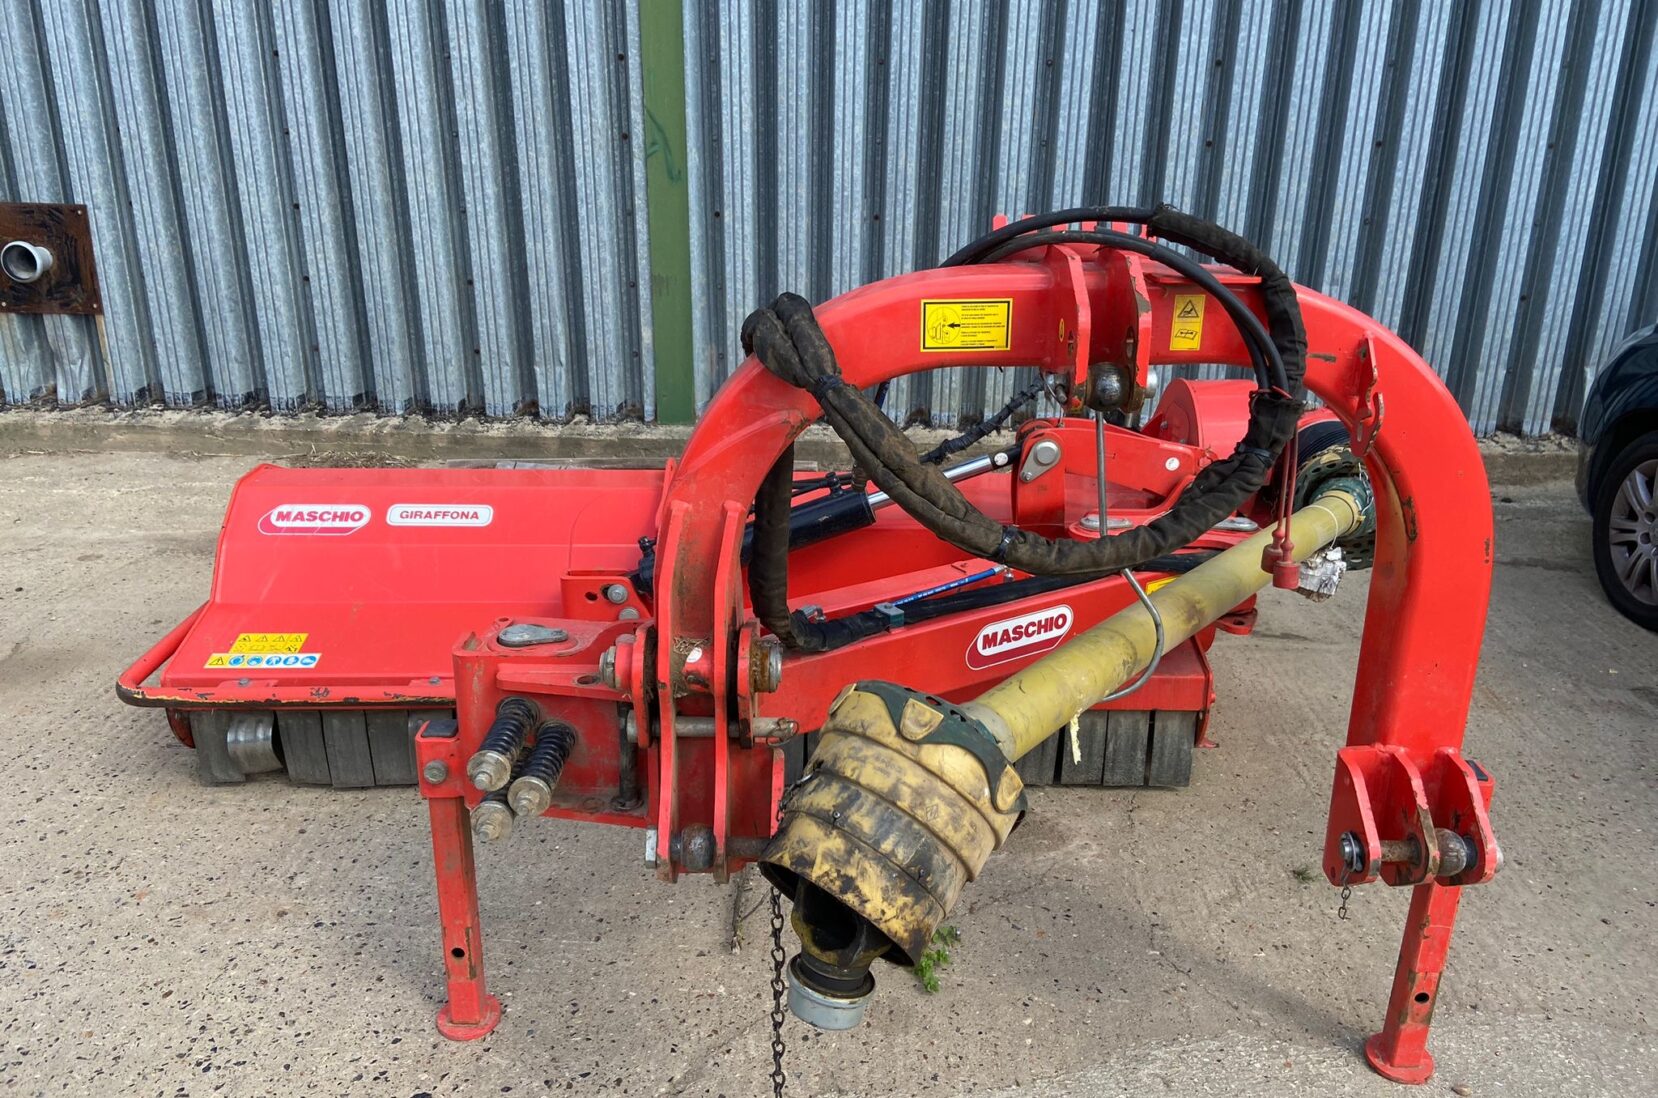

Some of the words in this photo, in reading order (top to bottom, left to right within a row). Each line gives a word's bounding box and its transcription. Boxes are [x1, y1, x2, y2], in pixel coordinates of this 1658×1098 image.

[275, 511, 364, 522] MASCHIO
[400, 510, 479, 520] GIRAFFONA
[982, 613, 1067, 650] MASCHIO
